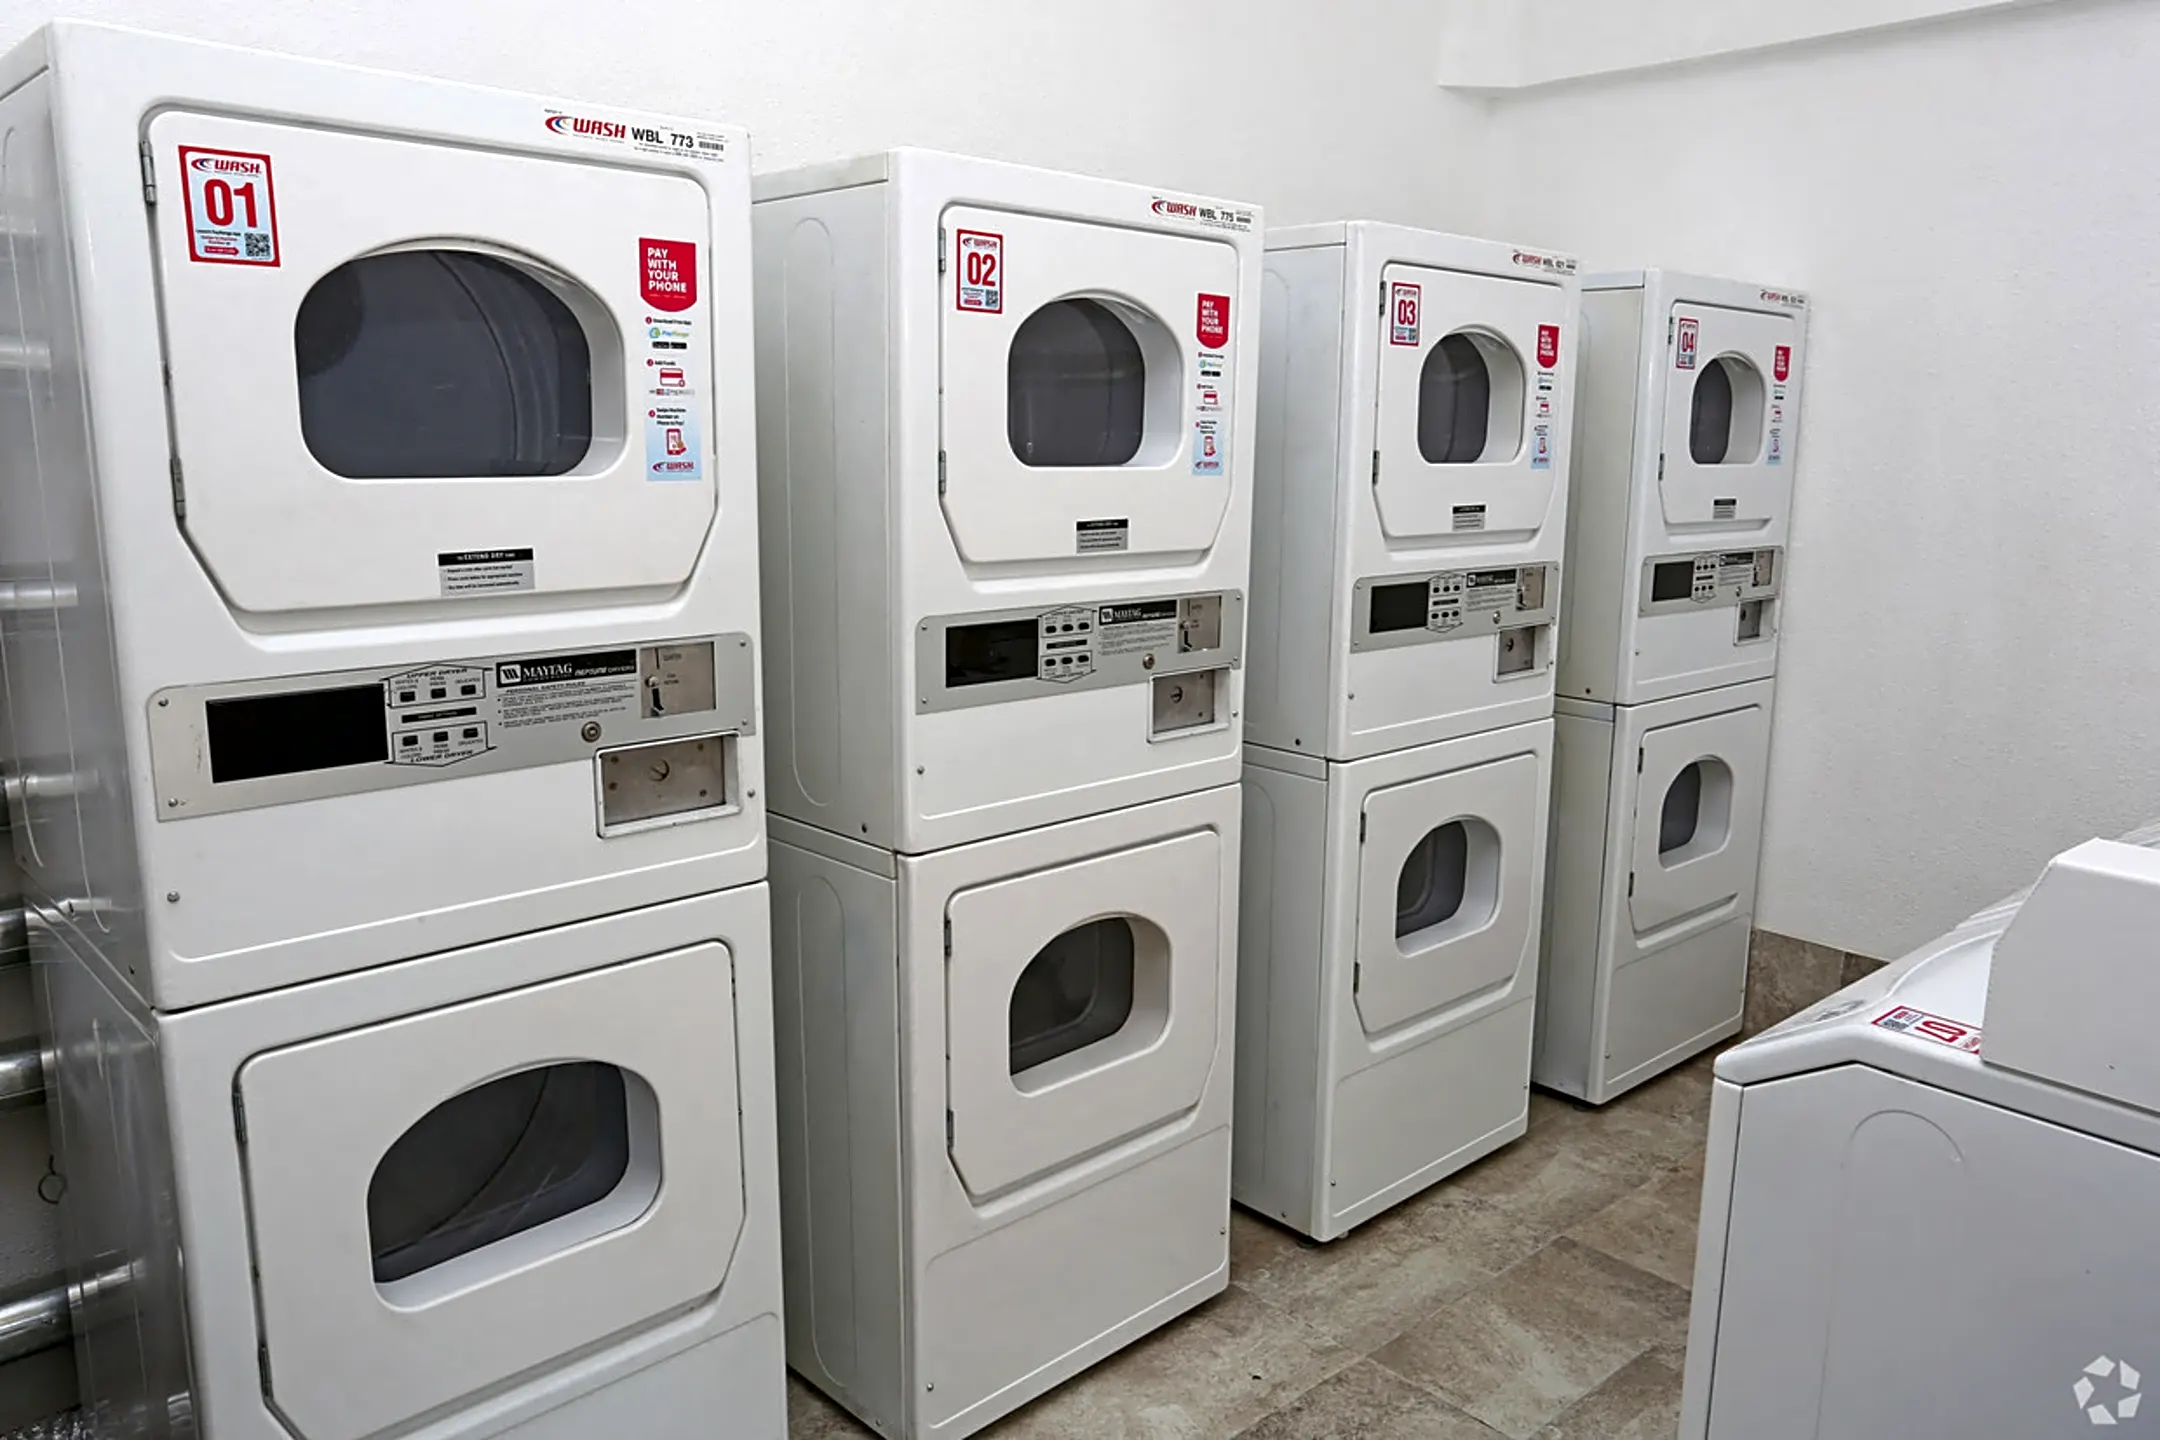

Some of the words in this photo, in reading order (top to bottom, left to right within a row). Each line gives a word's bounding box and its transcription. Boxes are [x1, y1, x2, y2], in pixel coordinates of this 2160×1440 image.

[573, 117, 627, 140] WASH
[631, 126, 664, 144] WBL
[670, 133, 694, 148] 773
[214, 159, 260, 174] WASH
[203, 178, 257, 228] 01
[1166, 202, 1198, 216] WASH
[647, 247, 668, 258] PAY
[647, 258, 677, 270] WITH
[967, 251, 996, 287] 02
[647, 269, 678, 281] YOUR
[648, 280, 687, 293] PHONE
[1398, 299, 1416, 325] 03
[1682, 331, 1694, 352] 04
[522, 662, 573, 678] MAYTAG
